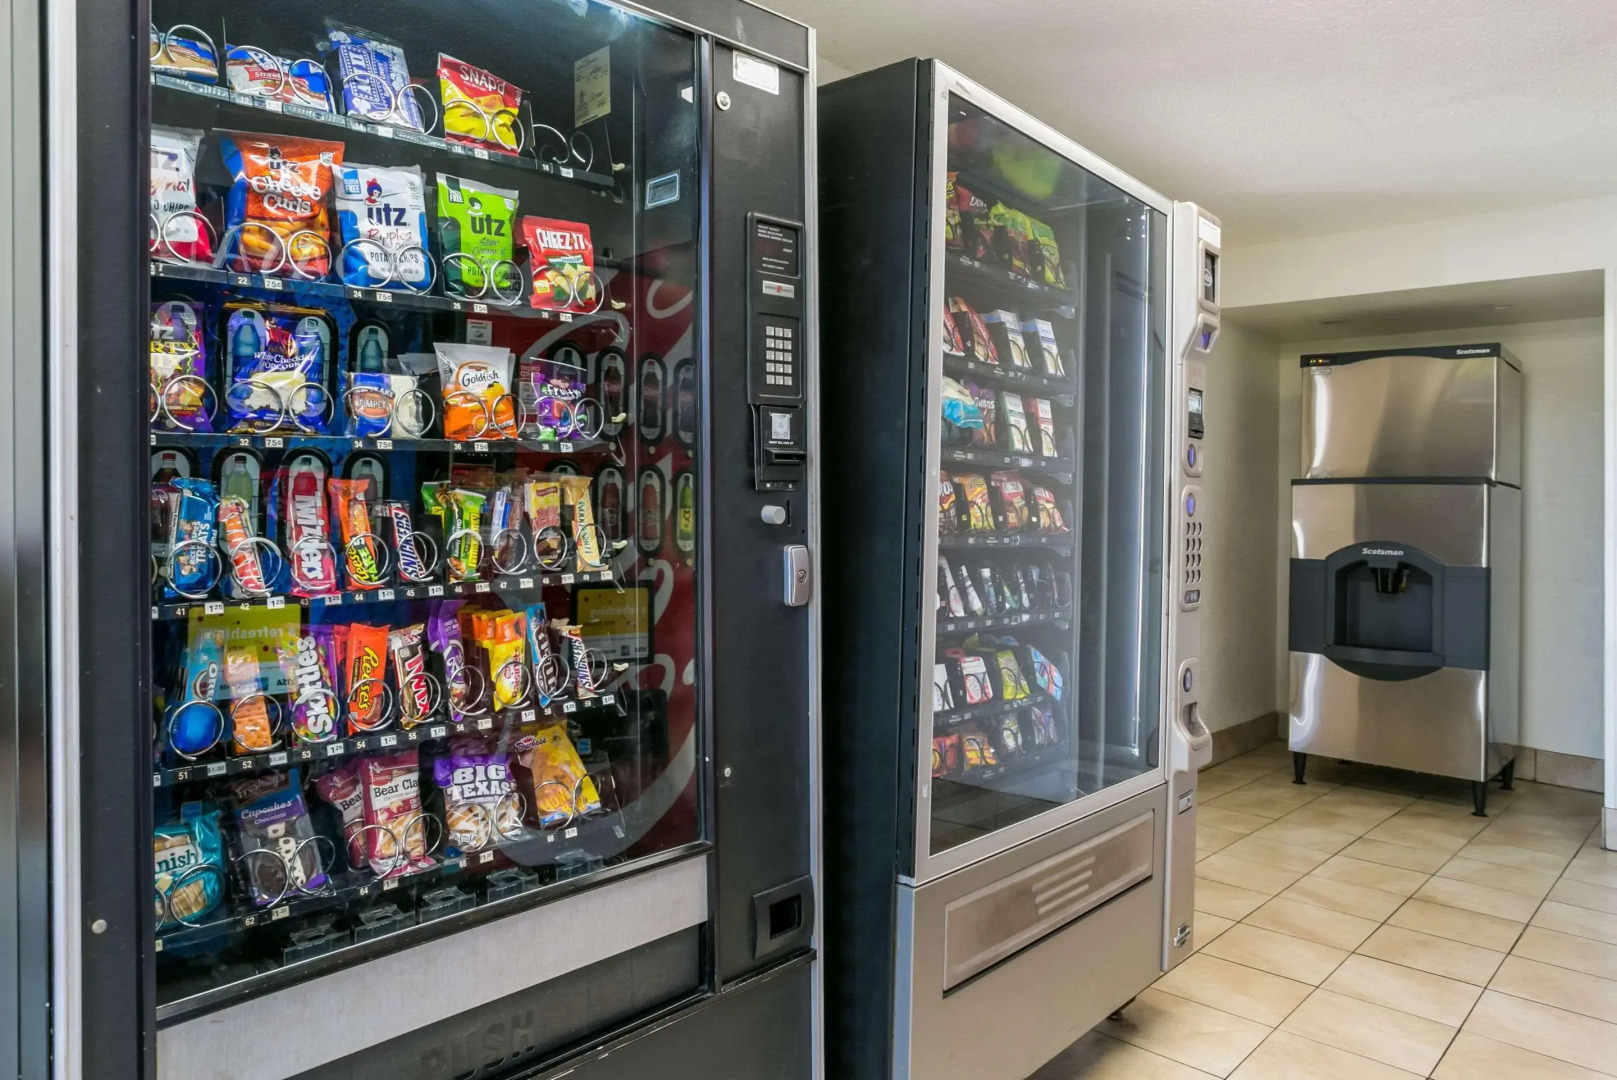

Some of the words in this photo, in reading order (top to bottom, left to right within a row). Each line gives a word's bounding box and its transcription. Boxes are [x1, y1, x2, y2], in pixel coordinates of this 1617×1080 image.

[251, 175, 322, 201] Cheese
[345, 185, 361, 194] FREE
[262, 193, 311, 214] Curls
[449, 194, 464, 204] FREE
[366, 203, 408, 227] utz
[470, 214, 507, 238] utz
[238, 277, 248, 285] 22
[353, 290, 363, 298] 24
[462, 370, 500, 388] Goldfish
[239, 438, 249, 447] 32
[354, 440, 363, 449] 34
[453, 443, 462, 451] 36
[393, 511, 424, 580] SNICKERS
[1361, 547, 1404, 556] Scotsman
[499, 581, 508, 589] 47
[406, 589, 415, 597] 45
[454, 586, 463, 594] 46
[300, 598, 309, 606] 43
[355, 594, 364, 602] 44
[240, 602, 250, 611] 42
[176, 608, 186, 616] 41
[512, 646, 521, 698] Raisinets
[358, 646, 380, 711] Reese's
[405, 645, 430, 716] TWIX
[584, 700, 592, 708] 59
[544, 708, 552, 716] 58
[456, 724, 465, 732] 56
[408, 733, 417, 741] 55
[356, 741, 366, 750] 54
[516, 737, 548, 753] Duchess
[302, 751, 311, 759] 53
[242, 761, 253, 769] 52
[178, 772, 188, 780] 51
[453, 764, 506, 785] BIG
[374, 784, 400, 798] Bear
[402, 777, 420, 791] Cla
[446, 780, 511, 803] TEXAS
[340, 791, 364, 812] Bea
[240, 798, 294, 819] Cupcakes
[254, 811, 288, 826] Chocolate
[359, 888, 369, 896] 64
[245, 917, 255, 926] 62
